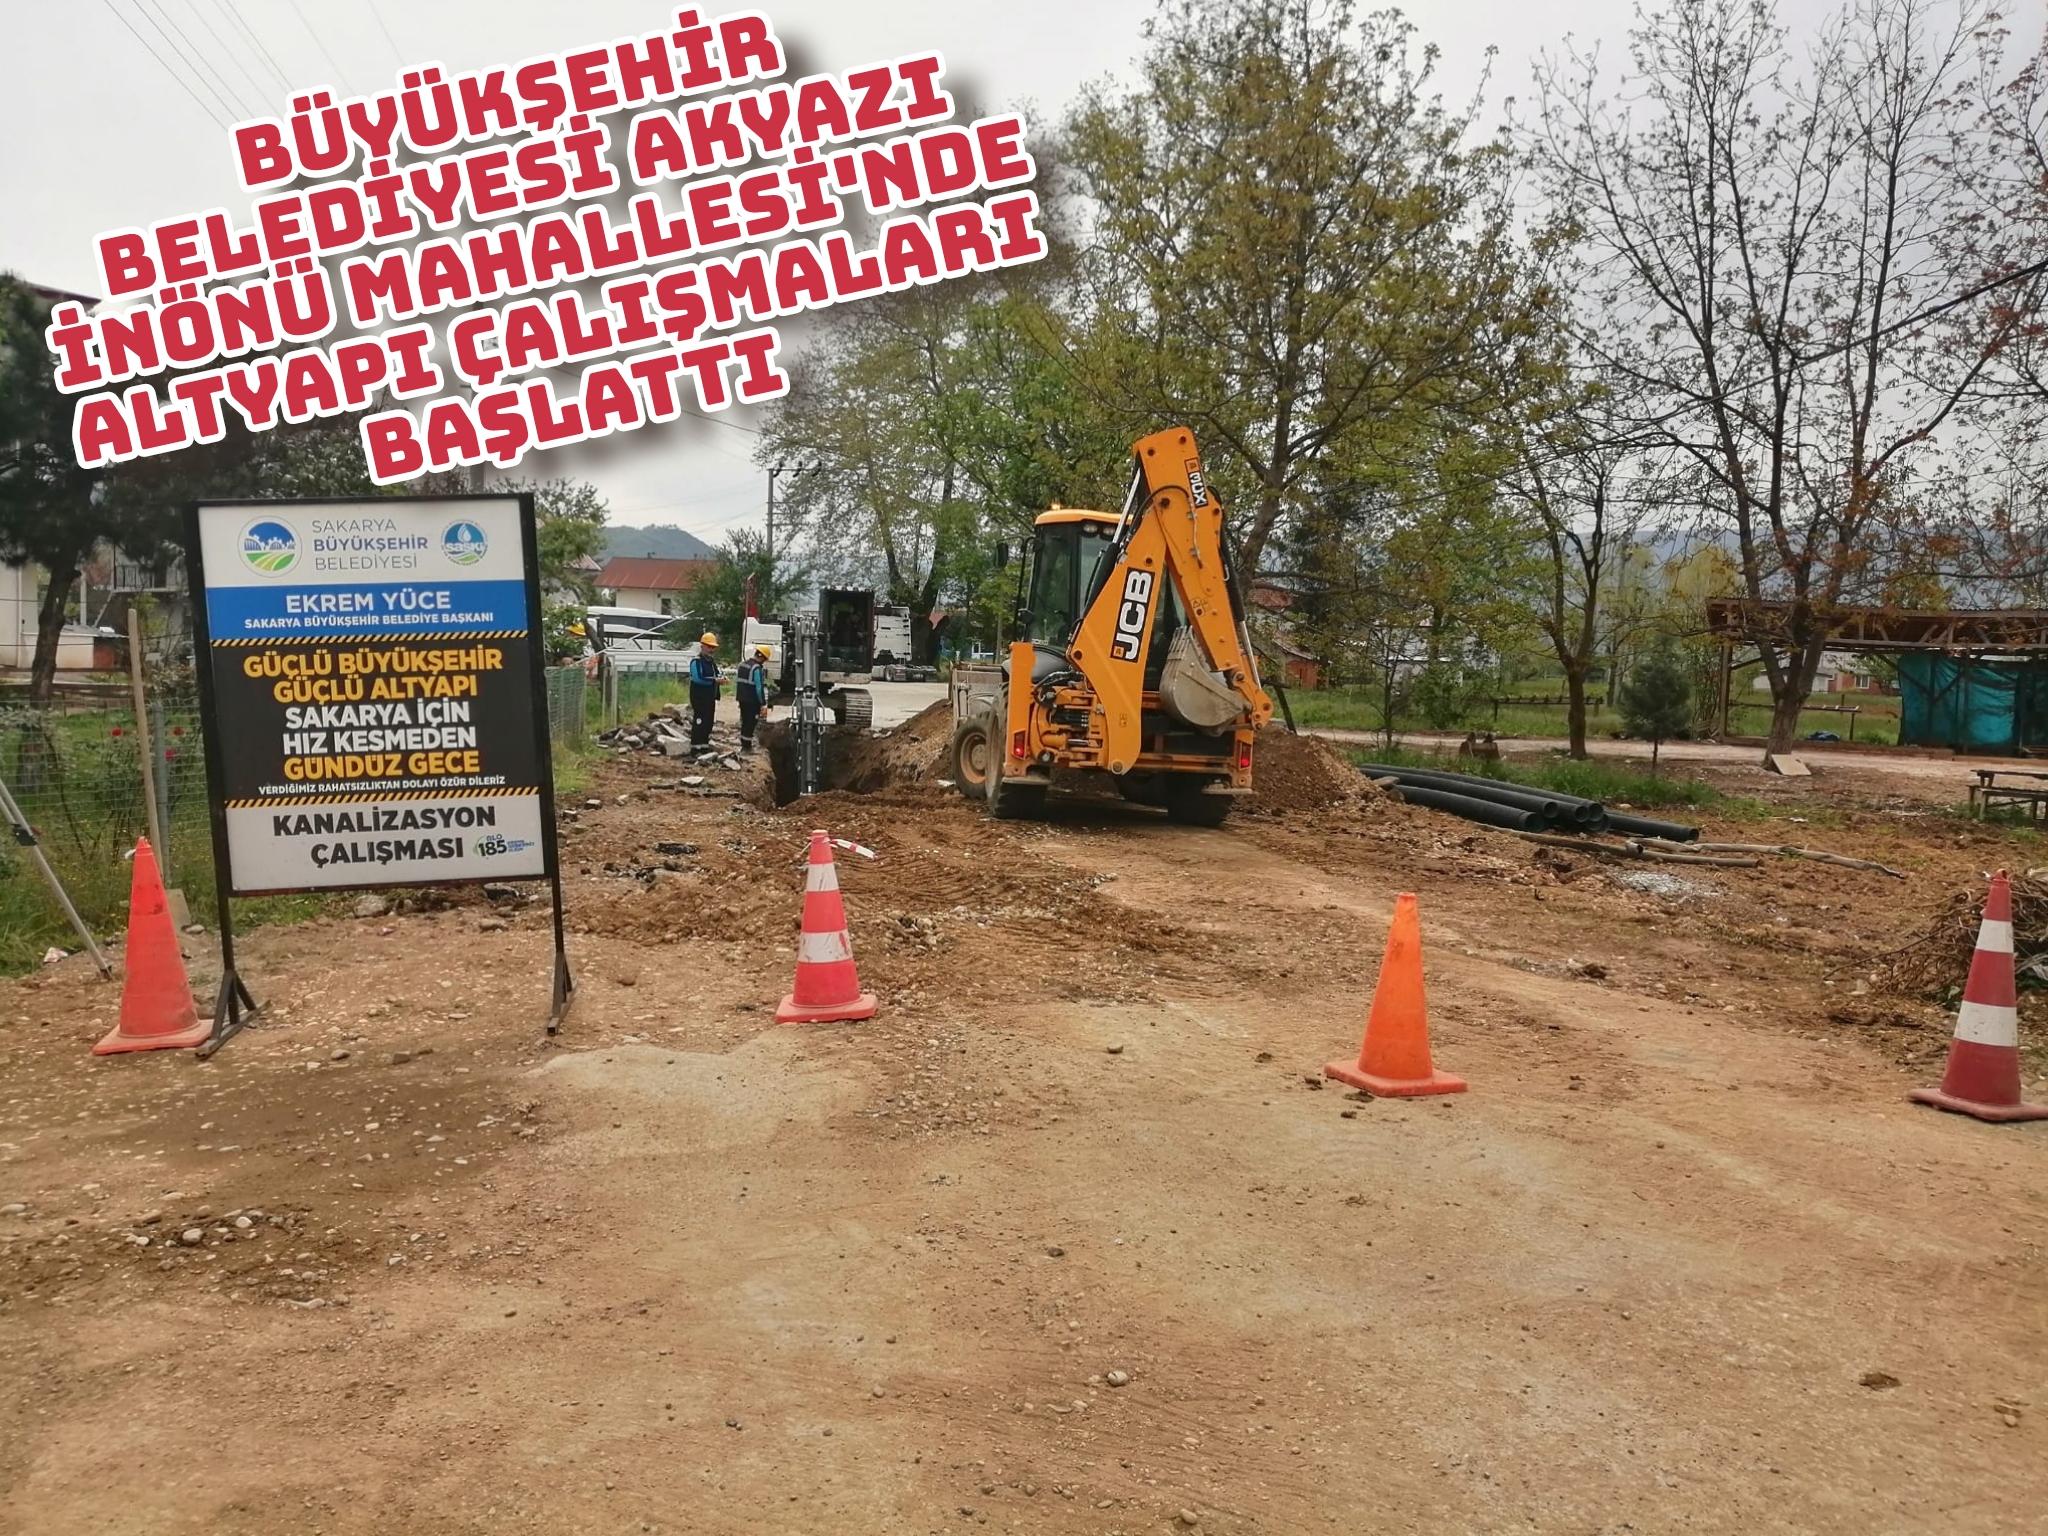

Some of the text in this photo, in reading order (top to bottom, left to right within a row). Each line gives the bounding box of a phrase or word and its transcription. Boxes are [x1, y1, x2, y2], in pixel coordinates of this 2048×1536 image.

[311, 518, 397, 534] SAKARYA
[313, 535, 429, 553] BÜYÜKŞEHİR
[314, 553, 418, 571] BELEDİYESİ
[285, 587, 452, 614] EKREM YÜCE
[1115, 570, 1152, 660] JCB
[243, 611, 494, 630] SAKARYA BÜYÜKŞEHİR BELEDİYE BAŞKANI
[243, 644, 504, 680] GÜÇLÜ BÜYÜKŞEHİR
[273, 675, 478, 706] GÜÇLÜ ALTYAPI
[284, 697, 471, 730] SAKARYA İÇİN
[282, 726, 477, 756] HIZ KESMEDEN
[283, 751, 481, 781] GÜNDÜZ GECE
[258, 774, 506, 796] VERDİĞİMİZ RAHATSIZLIKTAN DOLAYI ÖZÜR DİLERİZ
[272, 805, 497, 837] KANALİZASYON
[310, 837, 464, 869] ÇALIŞMASI
[478, 839, 508, 857] 185
